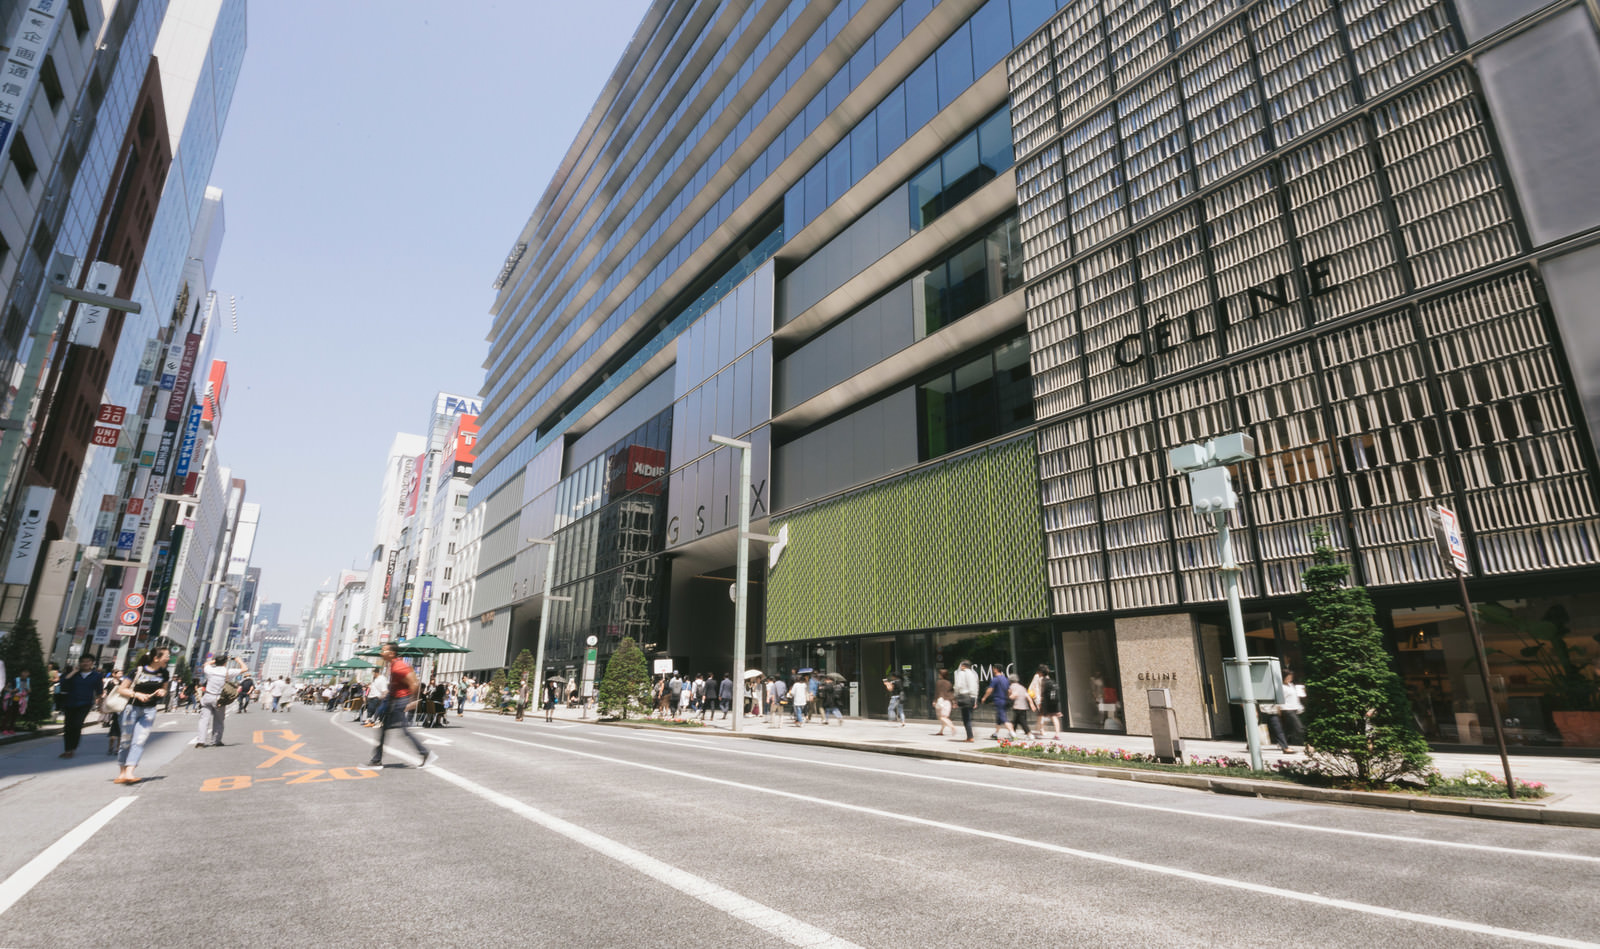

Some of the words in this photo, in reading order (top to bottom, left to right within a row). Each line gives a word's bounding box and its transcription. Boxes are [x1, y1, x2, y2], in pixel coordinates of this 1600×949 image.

[1114, 254, 1340, 367] CÉLINE
[96, 427, 116, 437] UNI
[94, 435, 116, 445] QLO
[16, 516, 39, 560] DIANA
[1137, 671, 1178, 681] CÉLINE
